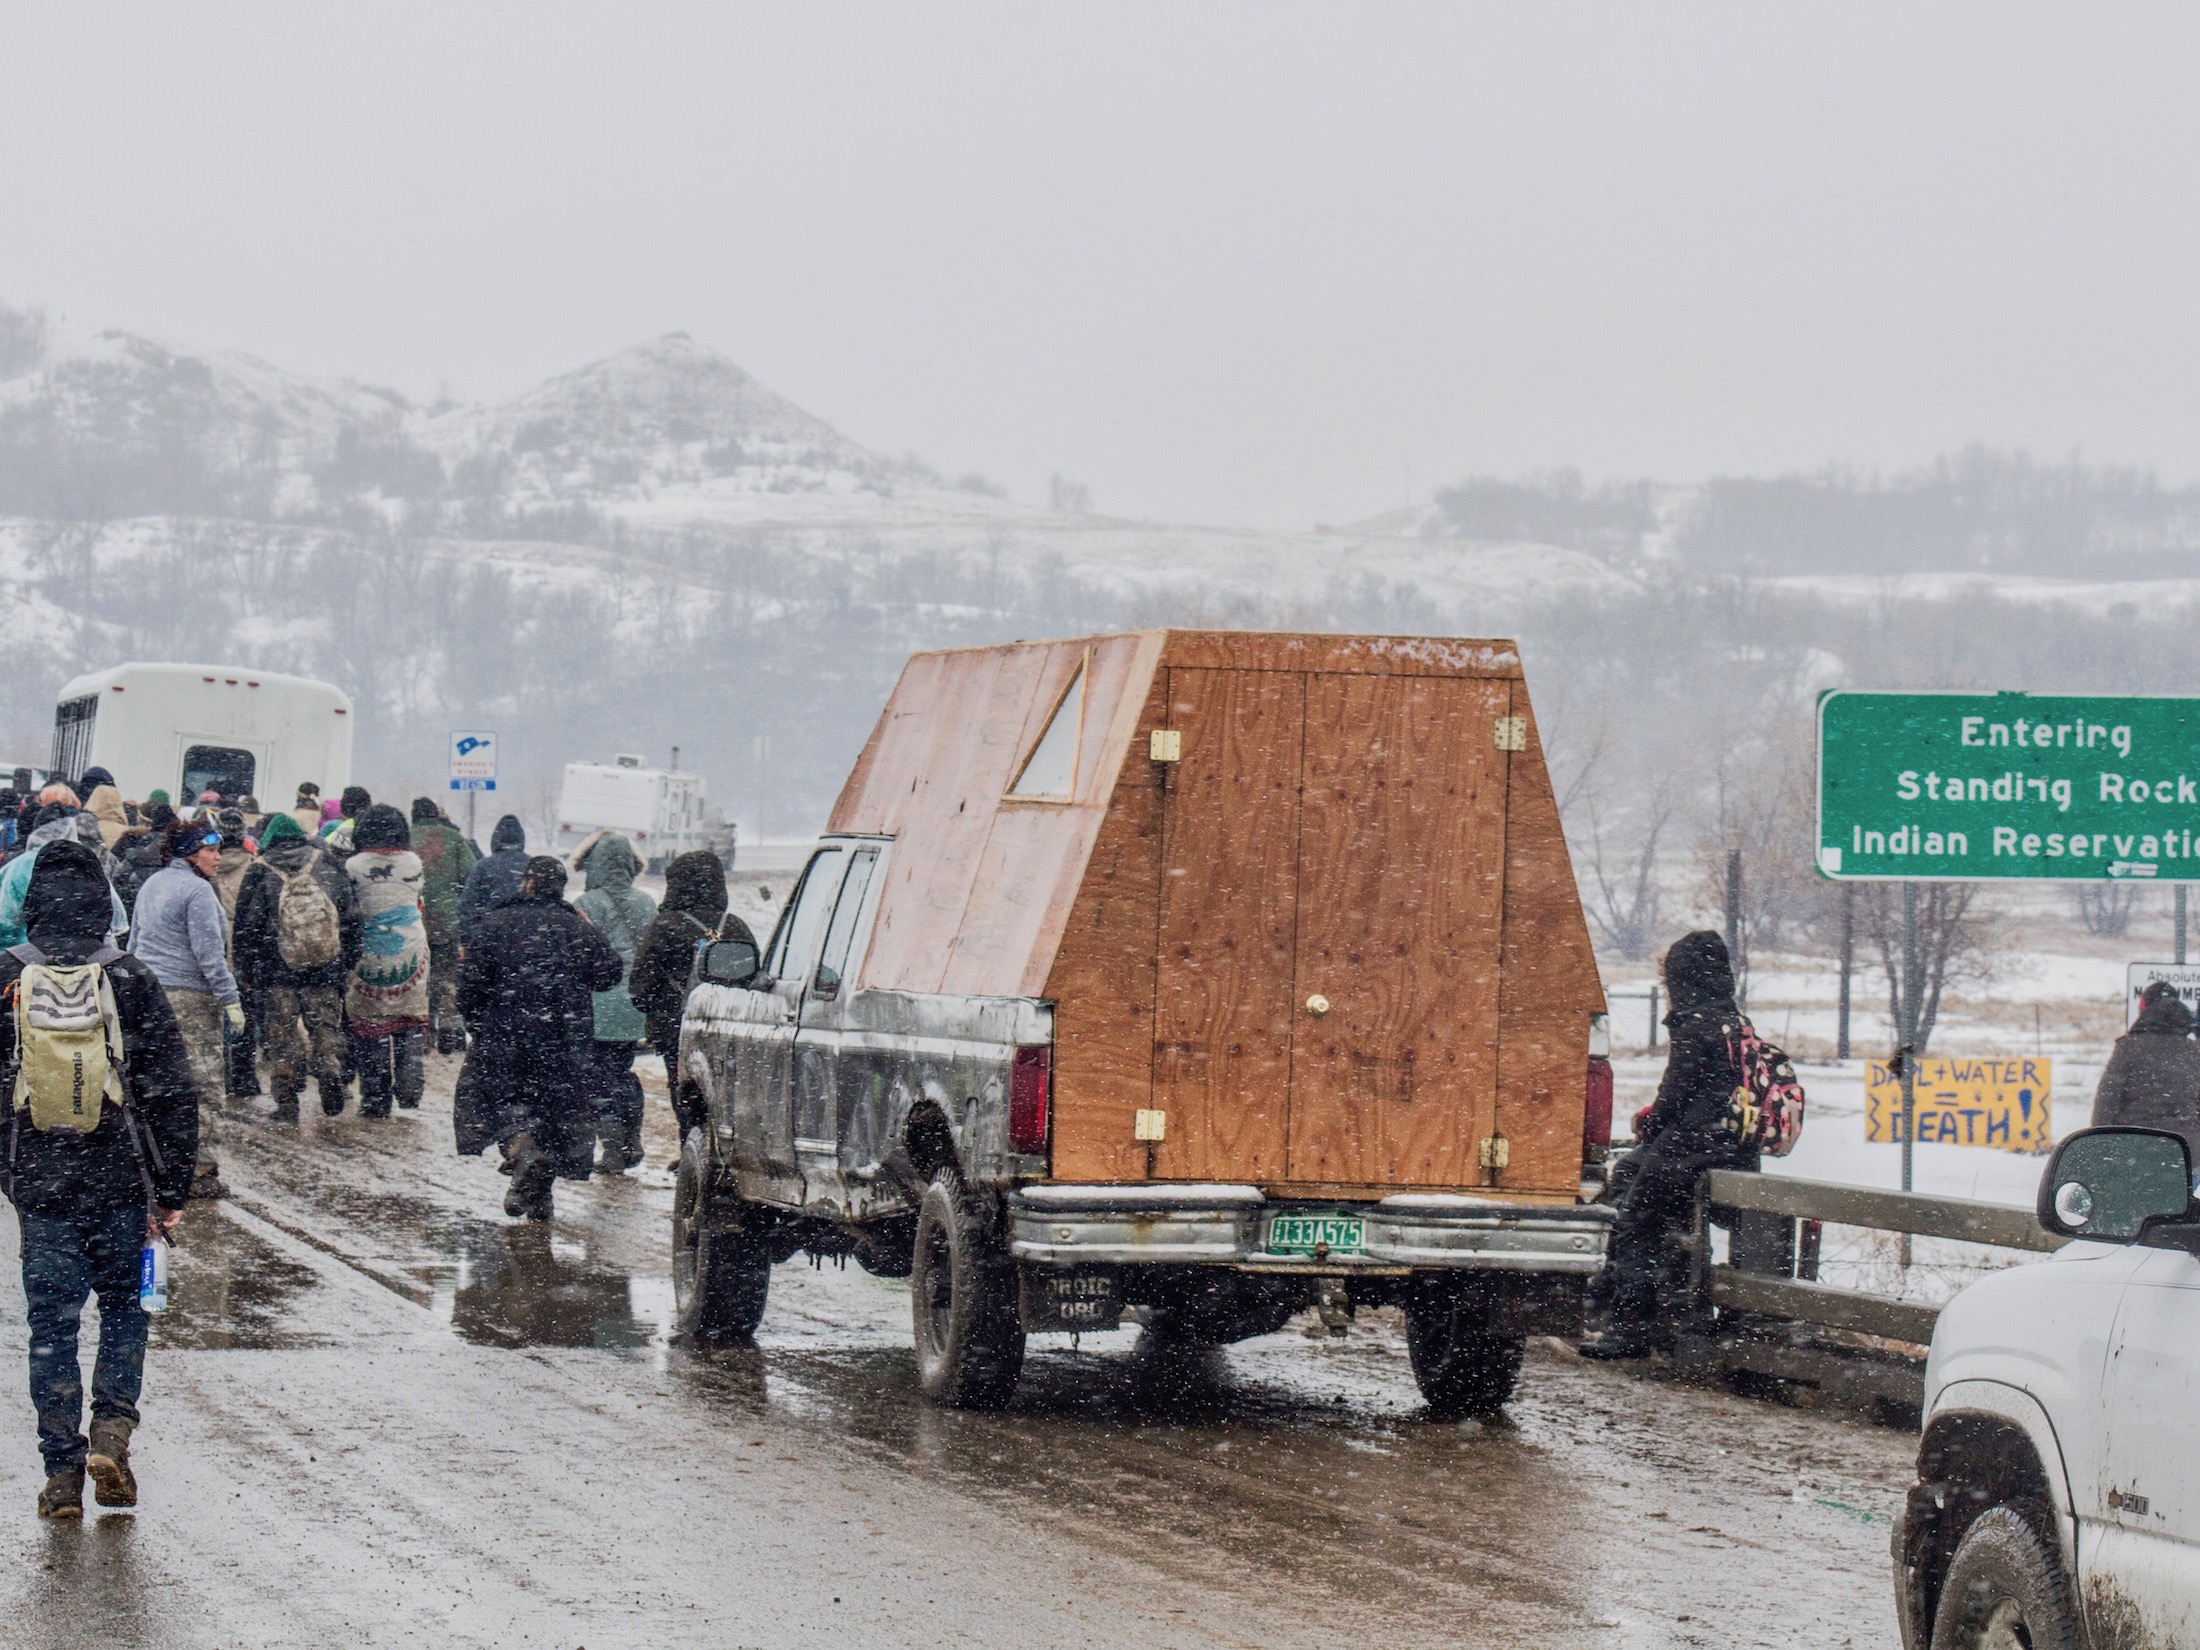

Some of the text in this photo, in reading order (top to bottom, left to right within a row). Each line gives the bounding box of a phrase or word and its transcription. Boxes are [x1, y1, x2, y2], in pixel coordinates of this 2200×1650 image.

[1962, 717, 2132, 758] Entering
[1897, 771, 2198, 812] Standing Rock
[1853, 825, 1968, 855] Indian
[73, 1051, 85, 1115] patagonia
[1950, 1060, 2041, 1087] WATER
[1891, 1089, 2032, 1144] DEATH!
[1281, 1220, 1361, 1246] 133A575
